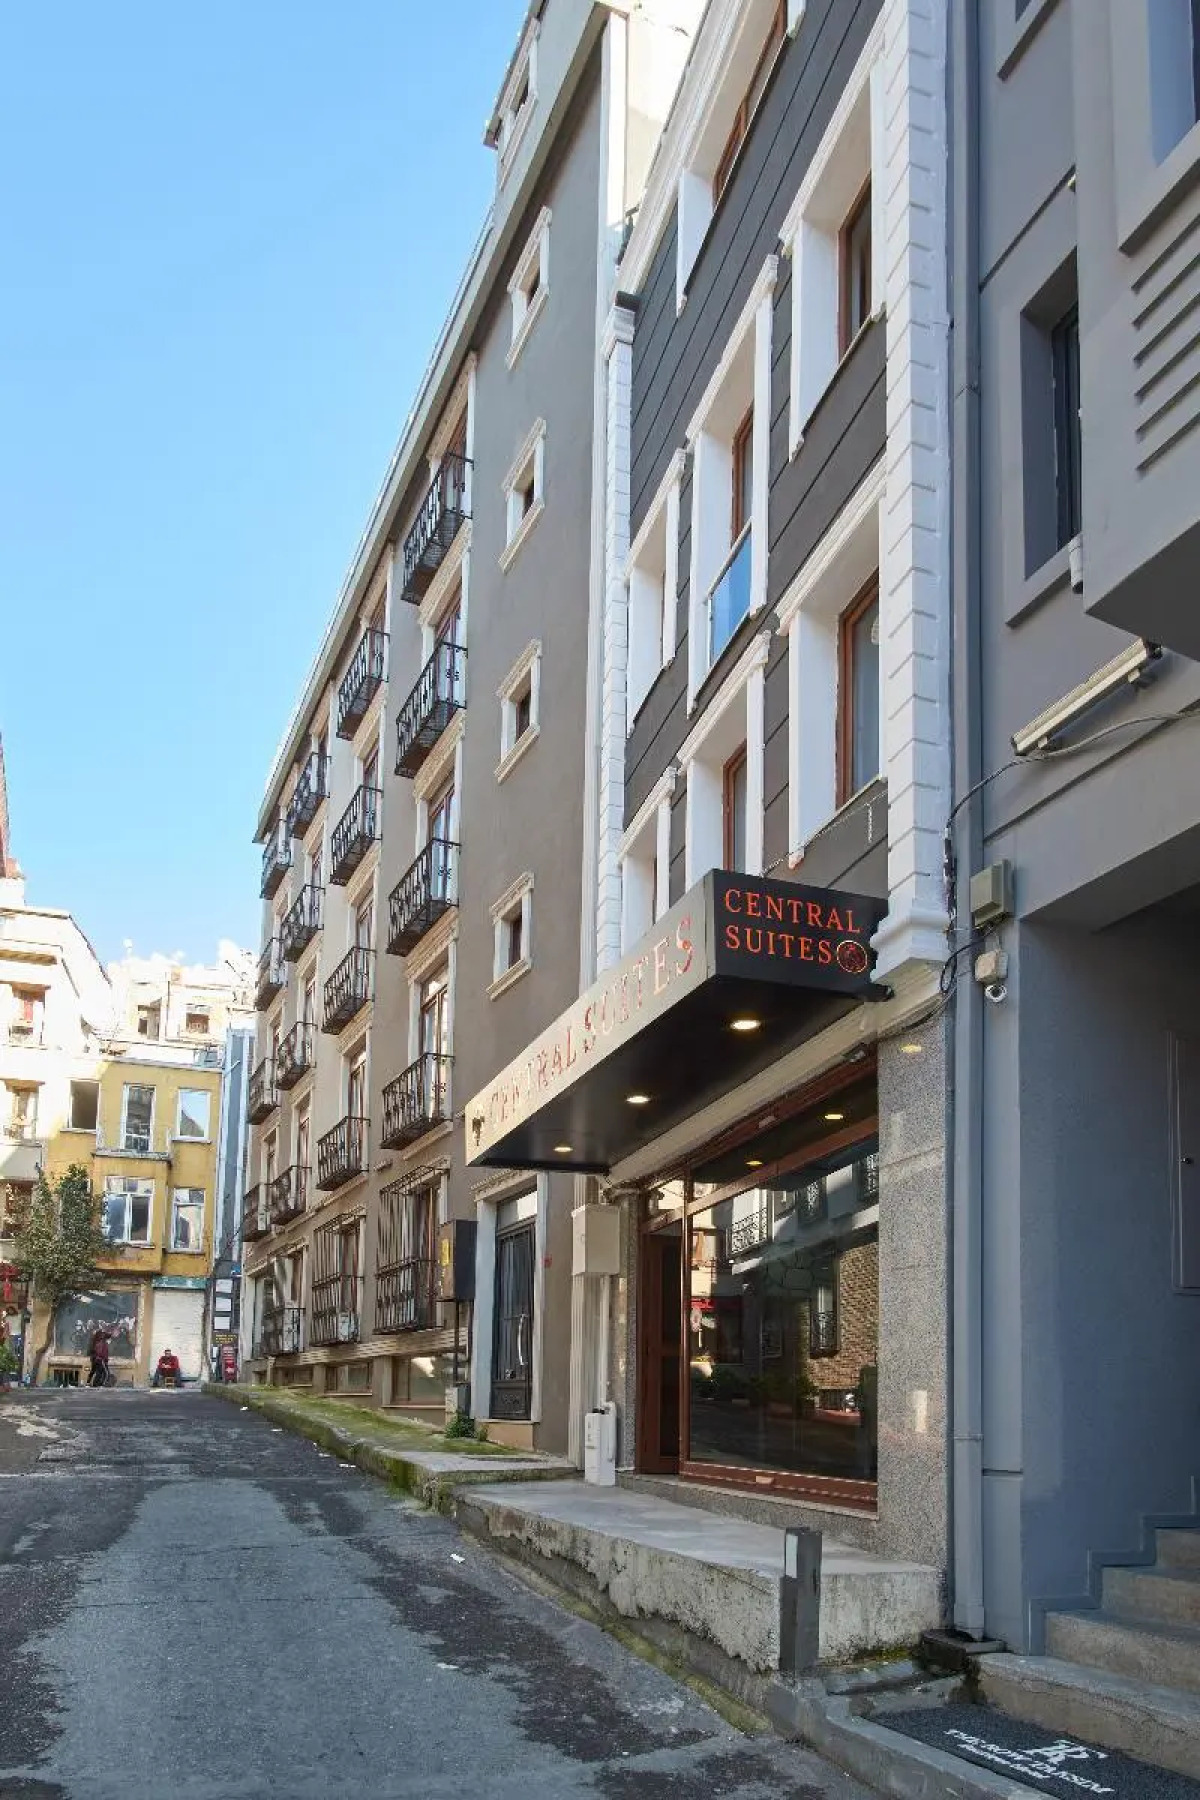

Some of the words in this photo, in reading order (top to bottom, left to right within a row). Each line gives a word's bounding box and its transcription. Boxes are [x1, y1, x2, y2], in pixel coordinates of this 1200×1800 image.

[725, 888, 862, 934] CENTRAL
[725, 924, 832, 965] SUITES
[490, 1026, 577, 1123] CENTRAL
[583, 911, 695, 1054] SUITES
